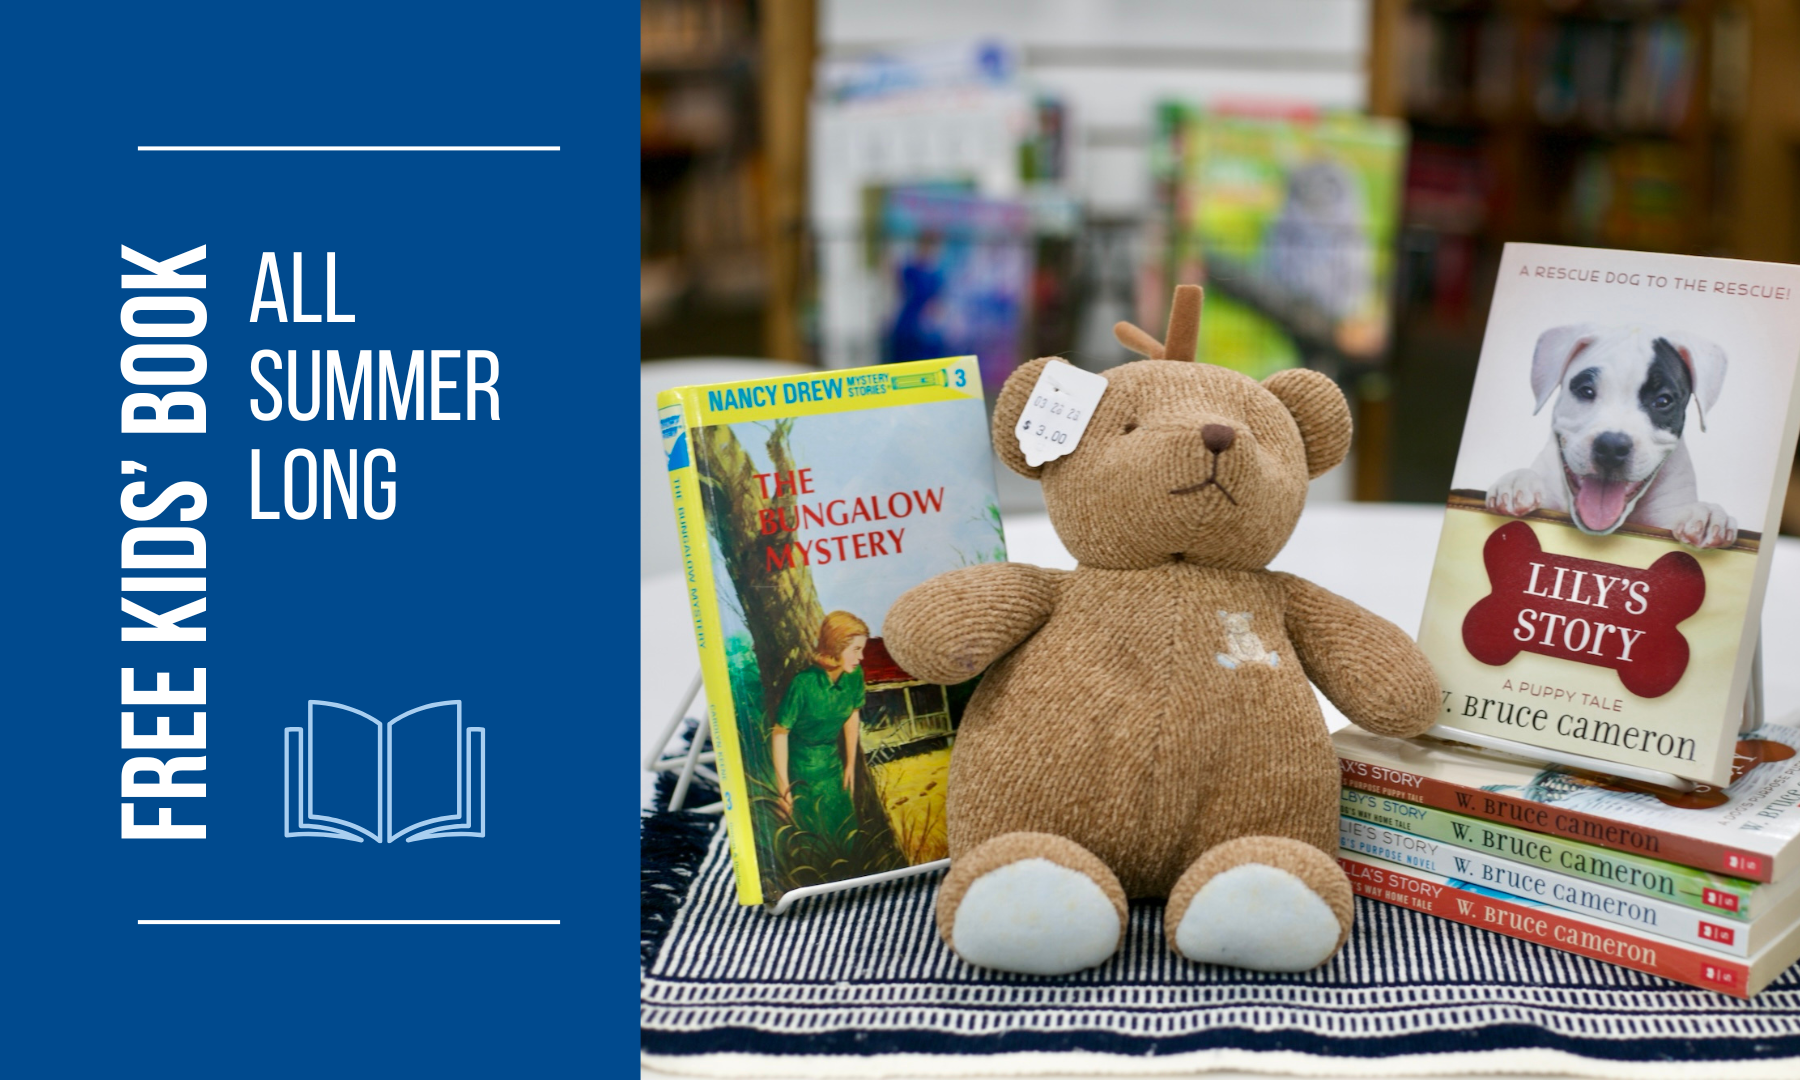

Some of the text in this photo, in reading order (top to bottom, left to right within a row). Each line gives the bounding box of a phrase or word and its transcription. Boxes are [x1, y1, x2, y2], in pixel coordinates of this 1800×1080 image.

[1519, 265, 1791, 301] A RESCUE DOG TO THE RESCUE!
[847, 373, 890, 387] MYSTERY
[955, 368, 967, 388] 3
[708, 377, 844, 412] NANCY DREW
[1023, 420, 1068, 445] $ 3.00
[753, 468, 815, 500] THE
[758, 486, 945, 535] BUNGALOW
[673, 477, 706, 649] THE BUNGALOW MYSTERY
[765, 528, 906, 573] MYSTERY
[1502, 679, 1624, 713] A PUPPY TALE
[1461, 695, 1549, 731] Bruce
[1349, 779, 1380, 793] PURPOSE
[1382, 787, 1406, 799] PUPPY
[1408, 792, 1424, 803] TALE
[1371, 767, 1424, 788] STORY
[724, 791, 733, 811] 3
[1382, 800, 1427, 820] STORY
[1455, 791, 1476, 811] W.
[1484, 798, 1549, 826] Bruce
[1357, 810, 1371, 820] WAY
[1374, 814, 1393, 826] HOME
[1395, 819, 1411, 831] TALE
[1360, 841, 1402, 862] PURPOSE
[1406, 855, 1436, 871] NOVEL
[1382, 831, 1439, 856] STORY
[1450, 821, 1473, 843] W.
[1481, 829, 1552, 862] Bruce
[1388, 874, 1443, 898] STORY
[1453, 856, 1474, 877] W.
[1481, 864, 1546, 895] Bruce
[1364, 884, 1382, 897] WAY
[1385, 890, 1409, 905] HOME
[1411, 897, 1433, 911] TALE
[1456, 898, 1477, 918] W.
[1484, 905, 1548, 937] Bruce
